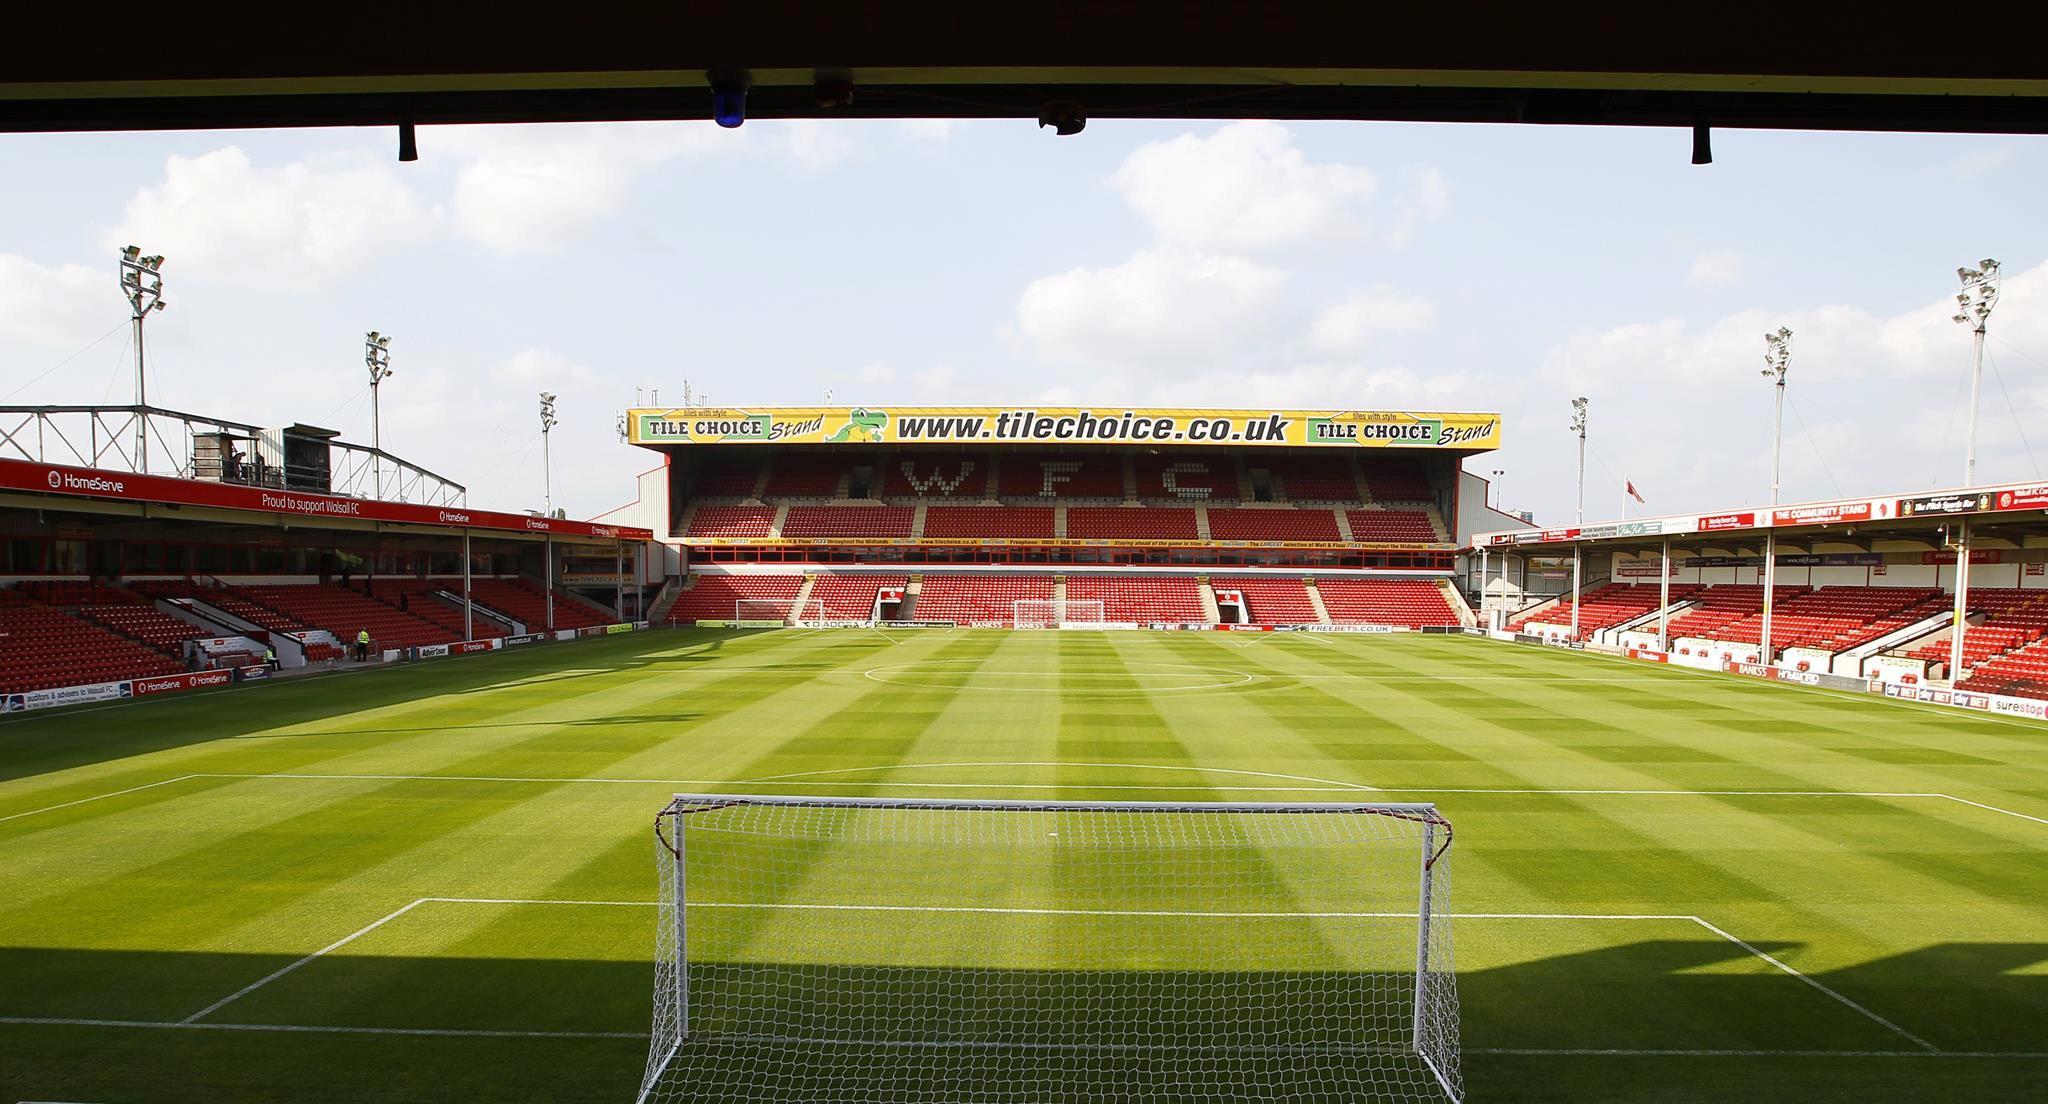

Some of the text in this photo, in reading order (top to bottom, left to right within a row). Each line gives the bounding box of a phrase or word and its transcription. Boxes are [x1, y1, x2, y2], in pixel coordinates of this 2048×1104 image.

[650, 421, 762, 435] TILE CHOICE
[767, 413, 824, 440] Stand
[899, 411, 1290, 442] www.tilechoice.co.uk
[1317, 424, 1432, 439] TILE CHOICE
[1437, 419, 1495, 446] Stand
[64, 473, 124, 493] HomeServe
[262, 493, 360, 515] Proud to support Walsall FC
[445, 511, 470, 523] HomeServe
[1776, 511, 1791, 520] THE
[1791, 506, 1837, 518] COMMUNITY
[1839, 504, 1867, 515] STAND
[1311, 625, 1390, 633] FREEBETS.CO.UK
[147, 681, 181, 692] HomeServe
[198, 674, 228, 685] HomeServe
[1900, 685, 1917, 699] BET
[1934, 691, 1951, 704] BET
[1954, 692, 1989, 709] sky BET
[1995, 700, 2043, 717] surestop
